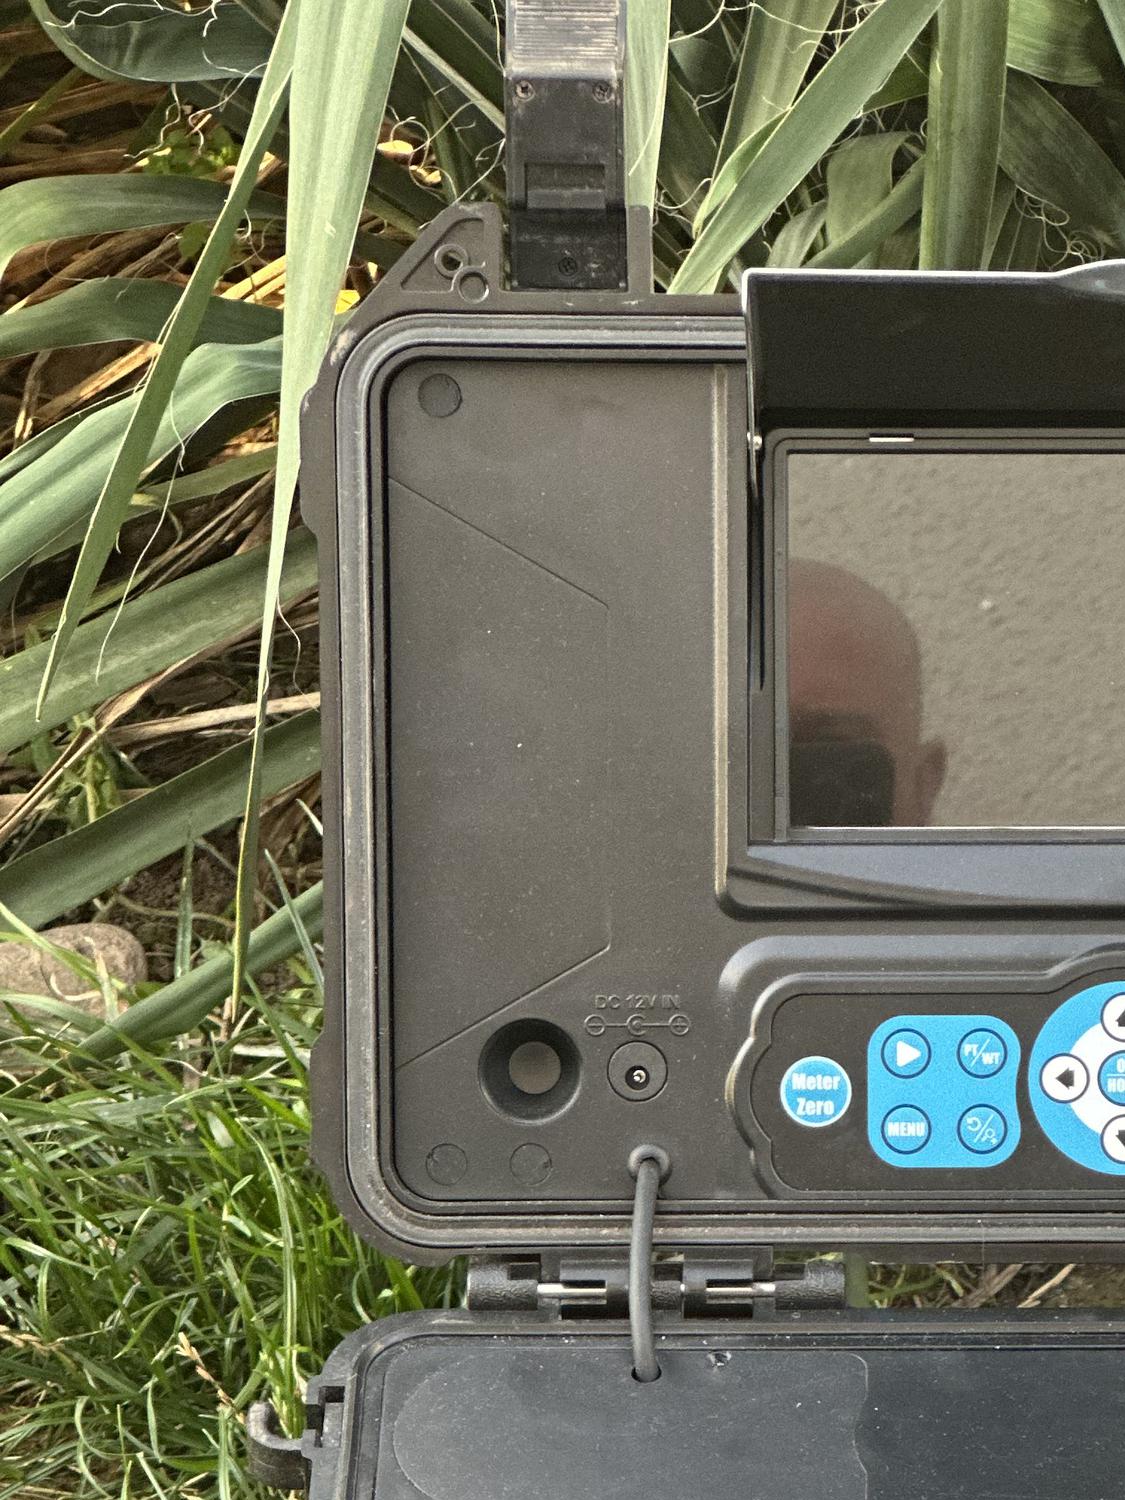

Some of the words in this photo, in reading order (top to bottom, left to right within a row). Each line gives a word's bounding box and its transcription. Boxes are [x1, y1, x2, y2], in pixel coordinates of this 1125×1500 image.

[791, 1072, 841, 1090] Meter
[796, 1097, 835, 1116] Zero
[887, 1121, 926, 1137] MENU
